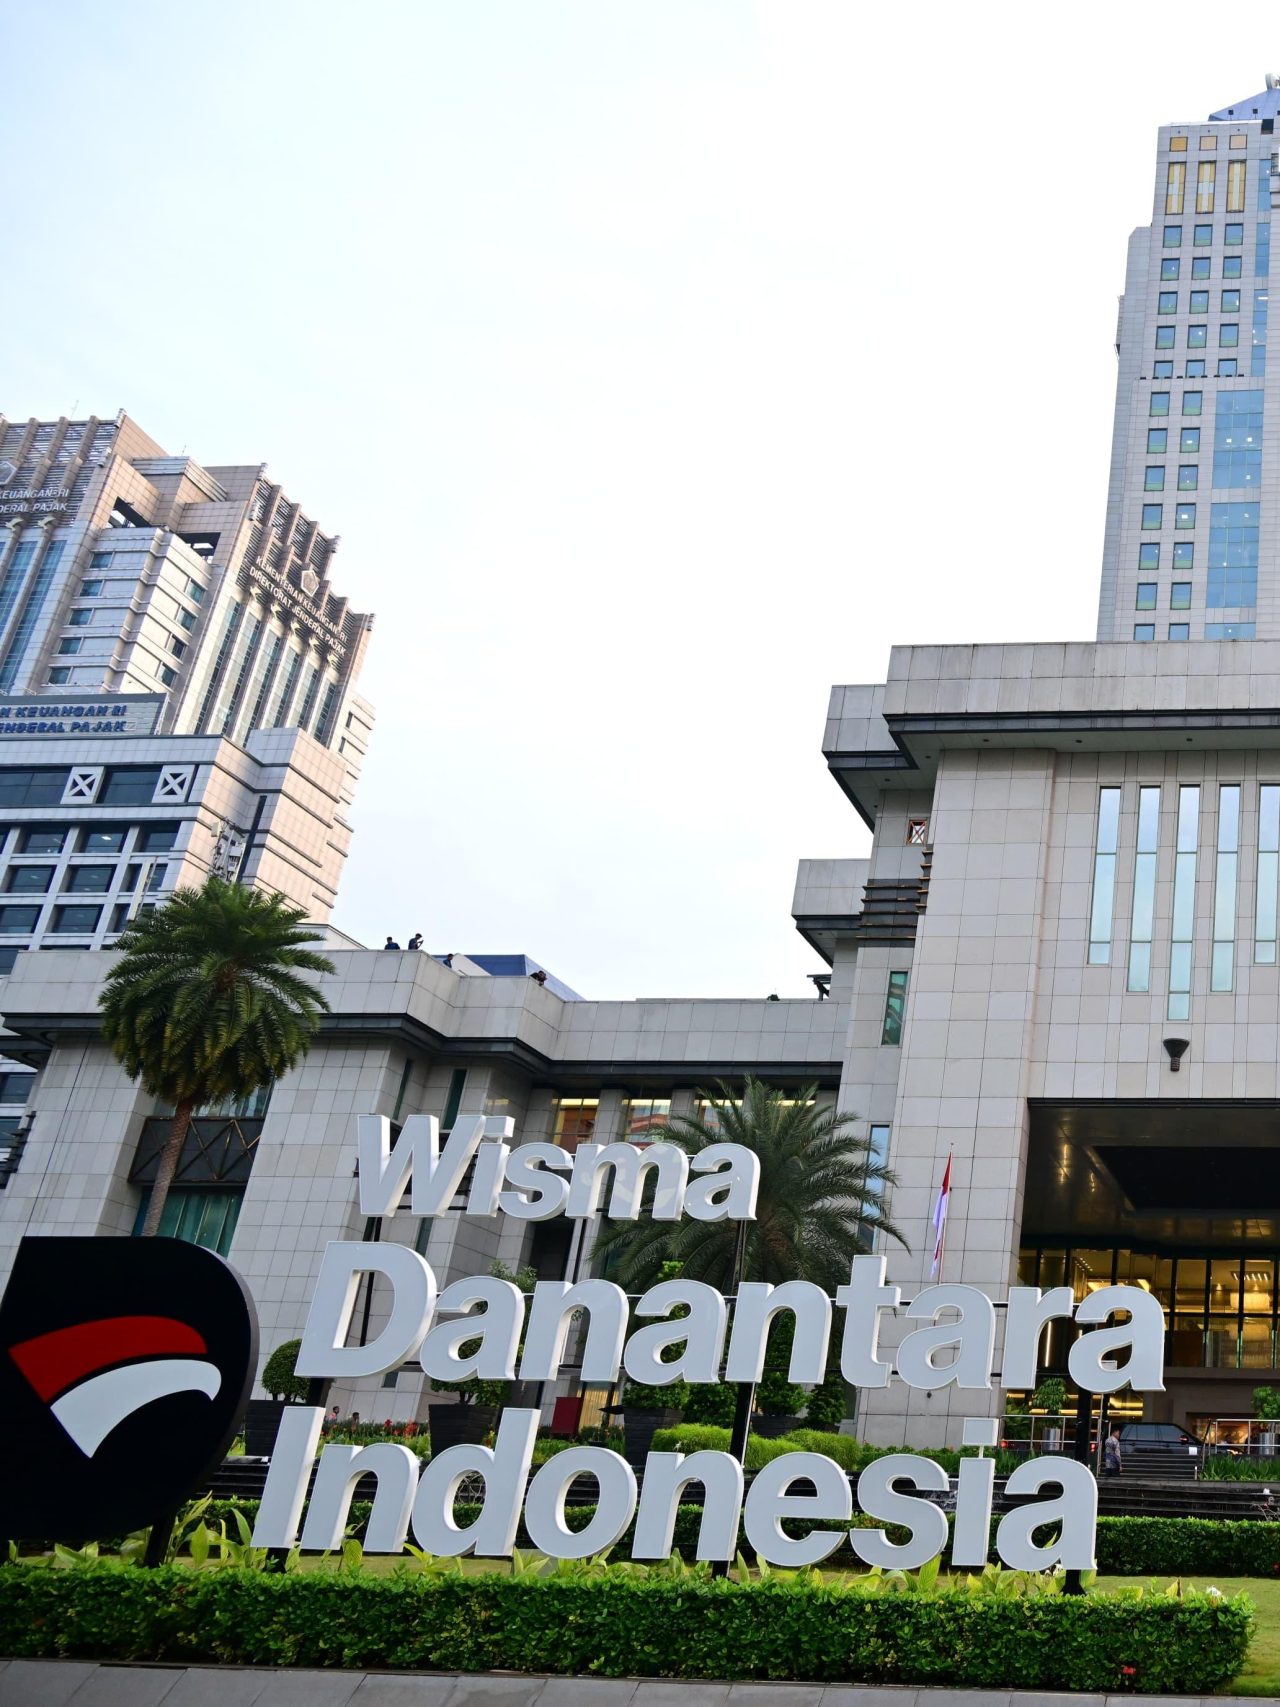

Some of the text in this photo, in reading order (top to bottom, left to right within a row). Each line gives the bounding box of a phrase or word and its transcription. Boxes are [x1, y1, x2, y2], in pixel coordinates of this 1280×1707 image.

[32, 502, 69, 512] PAJAK
[249, 566, 347, 657] DIREKTORAT JENDERAL PAJAK
[255, 555, 305, 604] KEMENTERIAN
[302, 598, 338, 635] KEUANGAN
[15, 705, 108, 718] KEUANGAN
[70, 720, 127, 733] PAJAK
[357, 1114, 761, 1222] Wisma
[294, 1241, 1166, 1393] Danantara
[251, 1406, 1099, 1573] Indonesia
